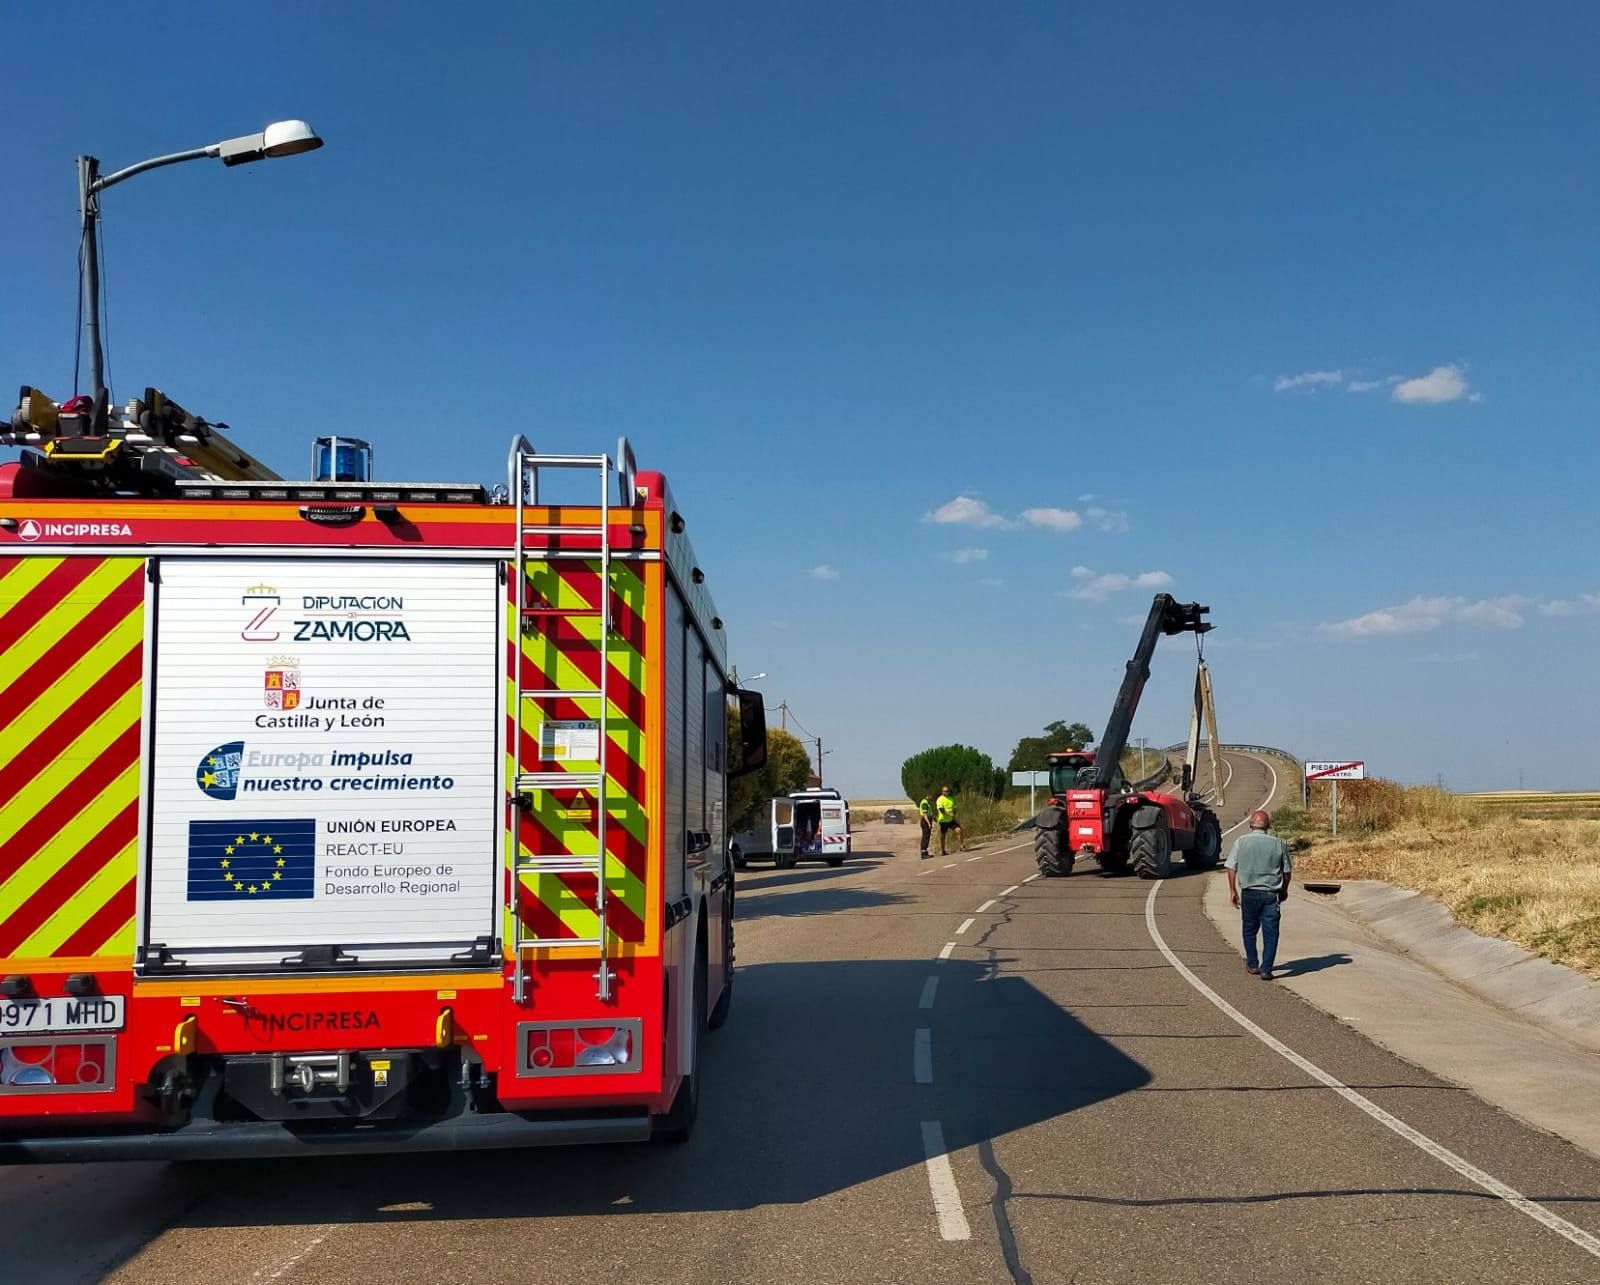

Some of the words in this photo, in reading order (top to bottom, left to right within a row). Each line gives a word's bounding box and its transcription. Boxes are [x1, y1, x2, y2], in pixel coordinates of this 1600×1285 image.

[45, 523, 133, 537] INCIPRESA
[293, 620, 412, 642] ZAMORA
[305, 696, 357, 710] Junta
[362, 696, 385, 709] de
[255, 714, 319, 728] Castilla
[324, 717, 335, 732] y
[340, 714, 385, 728] León
[248, 751, 324, 772] Europa
[330, 749, 413, 771] impulsa
[243, 776, 323, 792] nuestro
[330, 774, 455, 791] crecimiento
[327, 818, 376, 834] UNIÓN
[381, 819, 457, 833] EUROPEA
[326, 842, 404, 856] REACT-EU
[325, 866, 369, 877] Fondo
[374, 864, 432, 880] Europeo
[436, 864, 453, 875] de
[325, 881, 396, 896] Desarrollo
[400, 880, 460, 896] Regional
[66, 1001, 116, 1025] MHD
[262, 1011, 380, 1031] INCIPRESA
